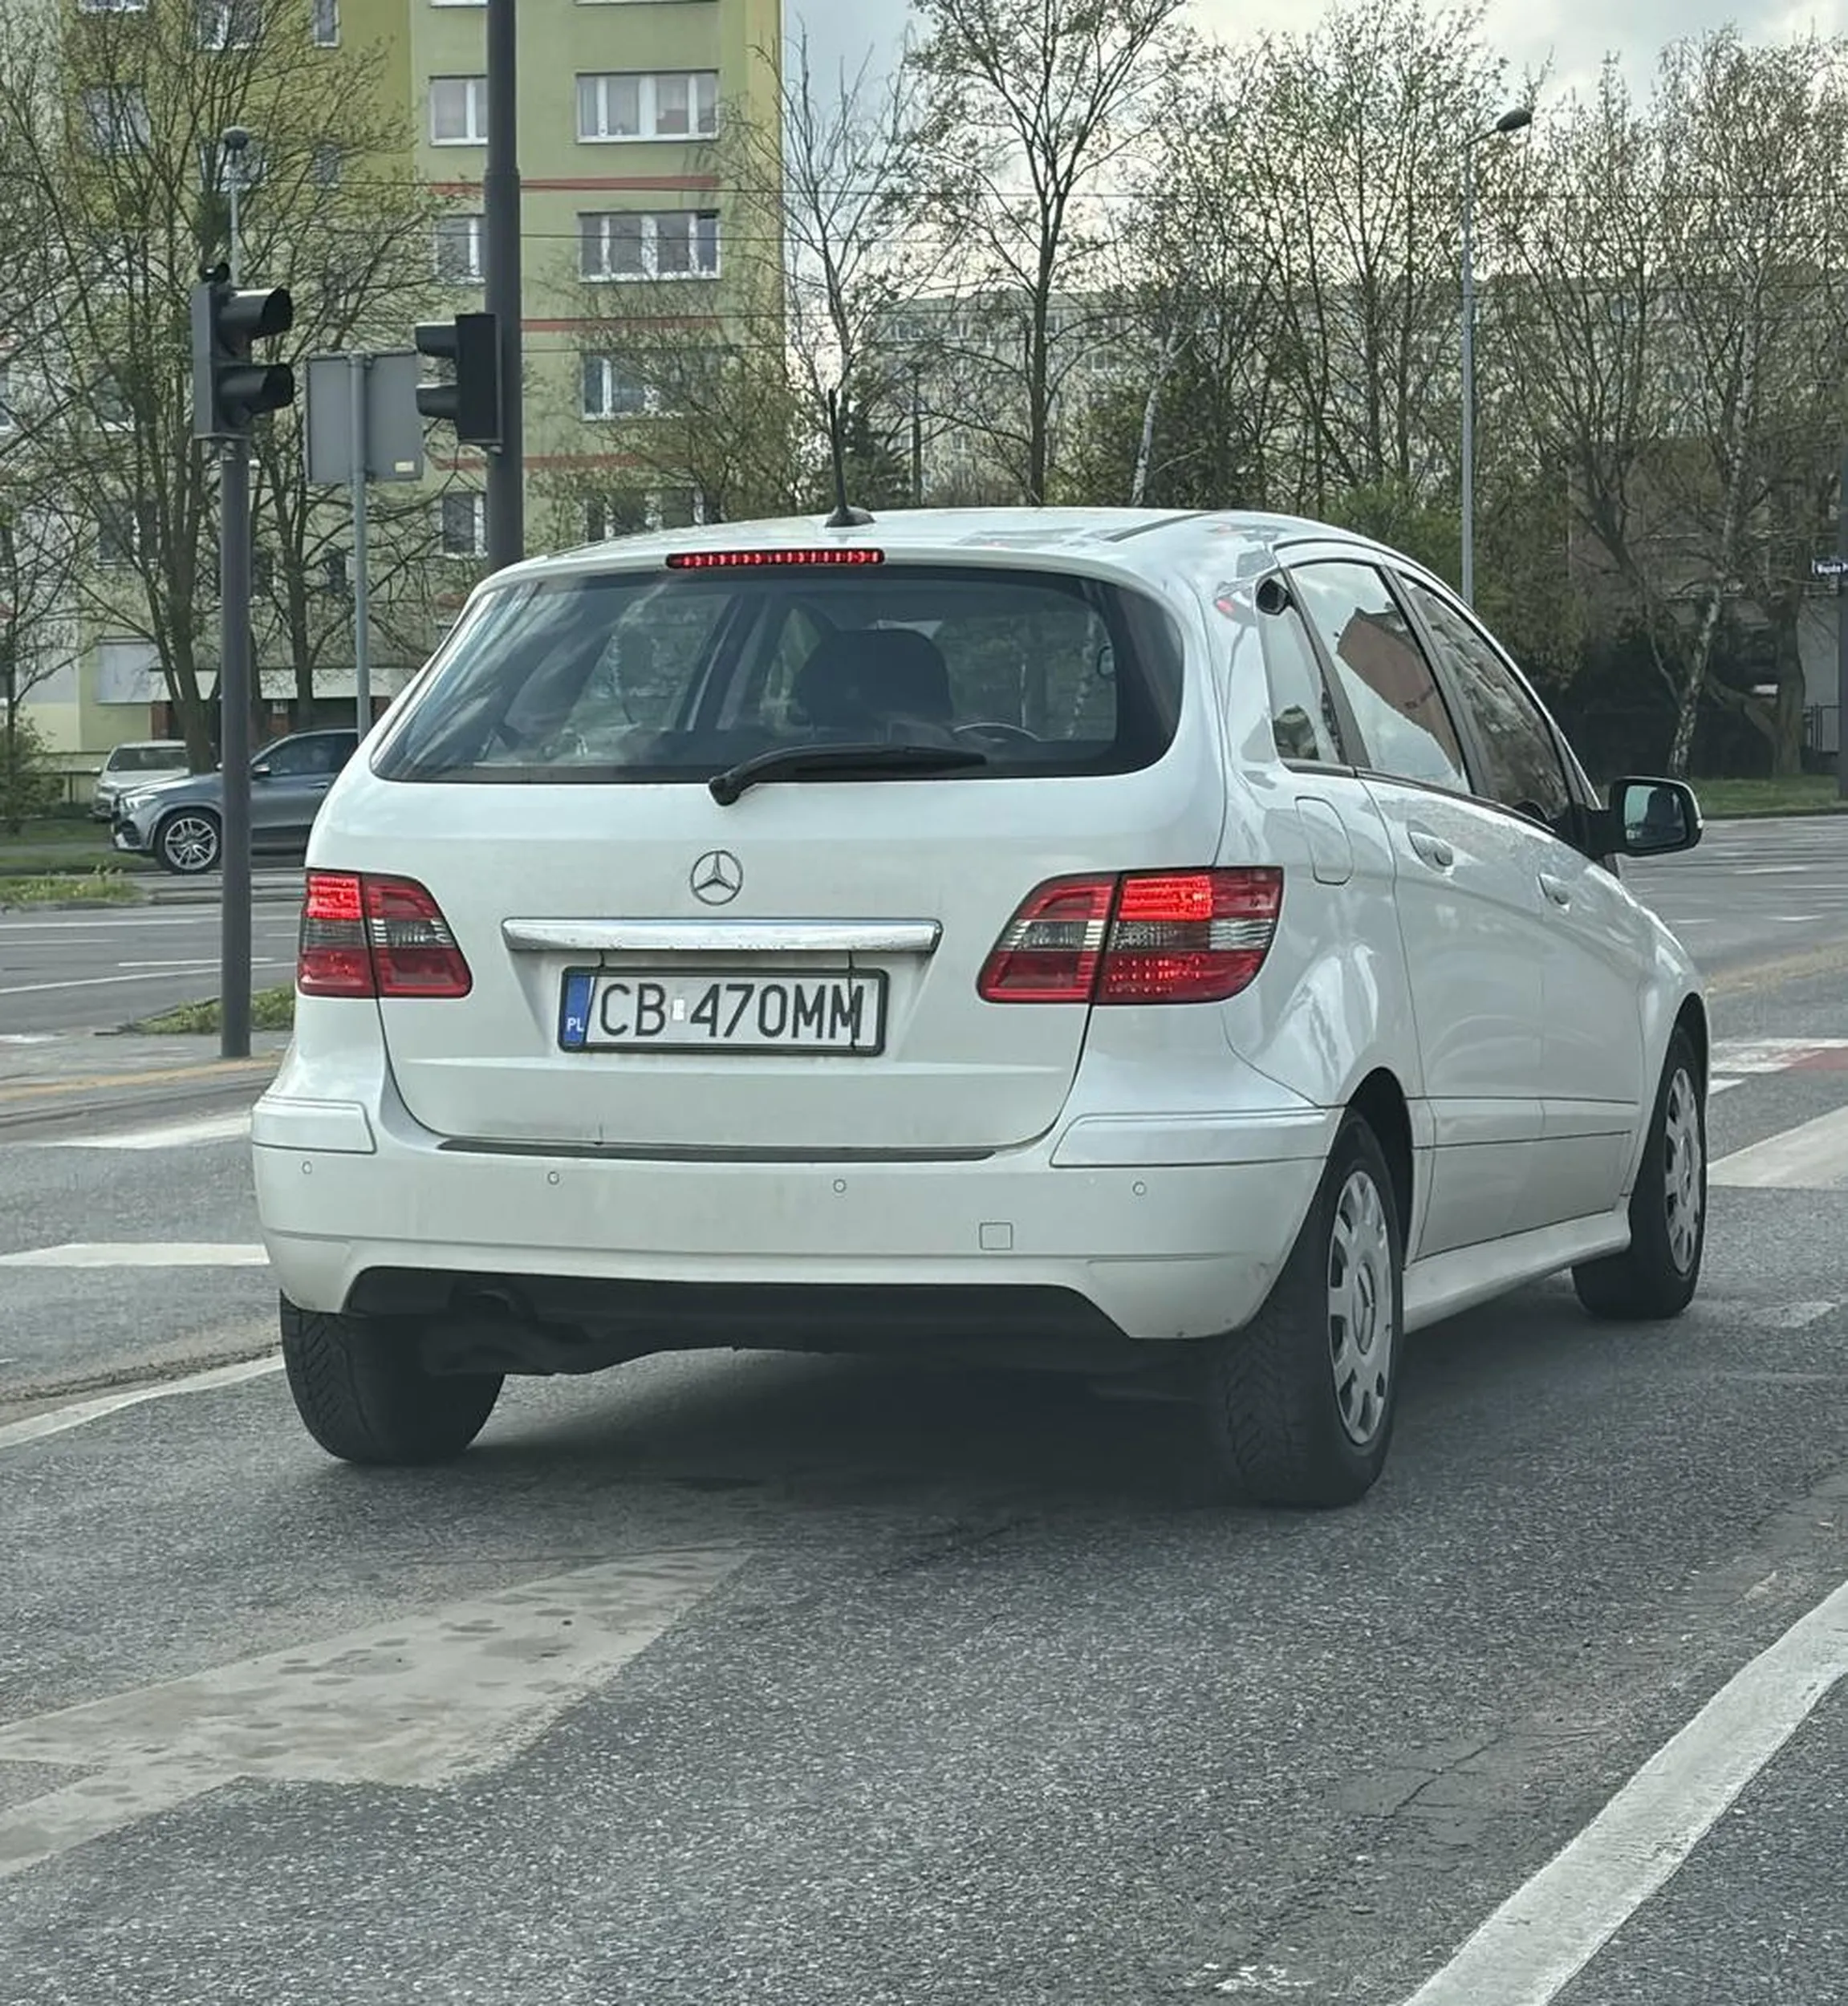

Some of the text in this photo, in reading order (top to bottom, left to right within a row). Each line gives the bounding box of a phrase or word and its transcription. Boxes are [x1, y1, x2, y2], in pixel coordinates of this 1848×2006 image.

[567, 1017, 585, 1033] PL
[600, 983, 865, 1039] CB 470MM
